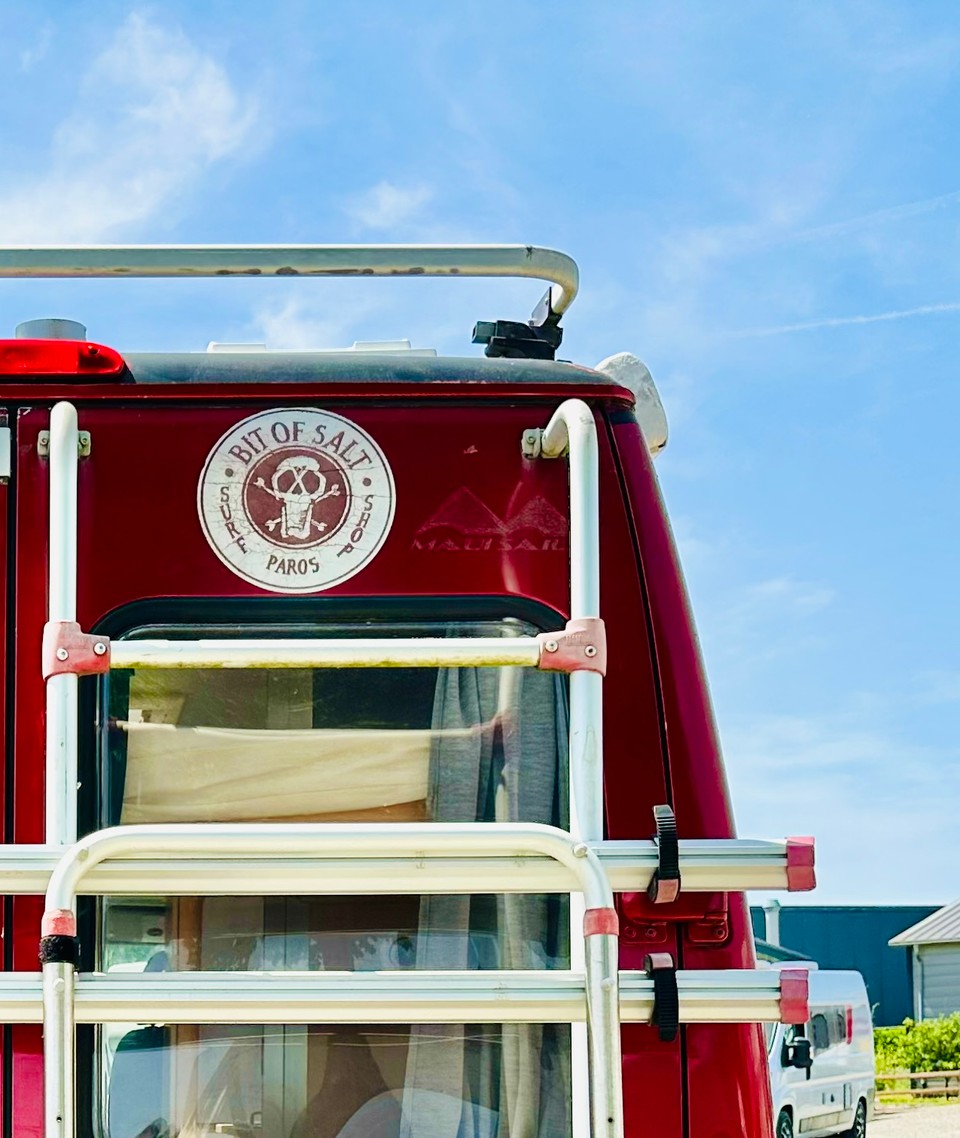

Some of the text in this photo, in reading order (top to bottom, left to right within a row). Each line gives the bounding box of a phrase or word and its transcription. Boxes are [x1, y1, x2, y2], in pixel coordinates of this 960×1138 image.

[228, 421, 373, 470] BIT OF SALT
[219, 486, 248, 554] SURF
[336, 494, 374, 558] SHOP
[265, 554, 321, 576] PAROS
